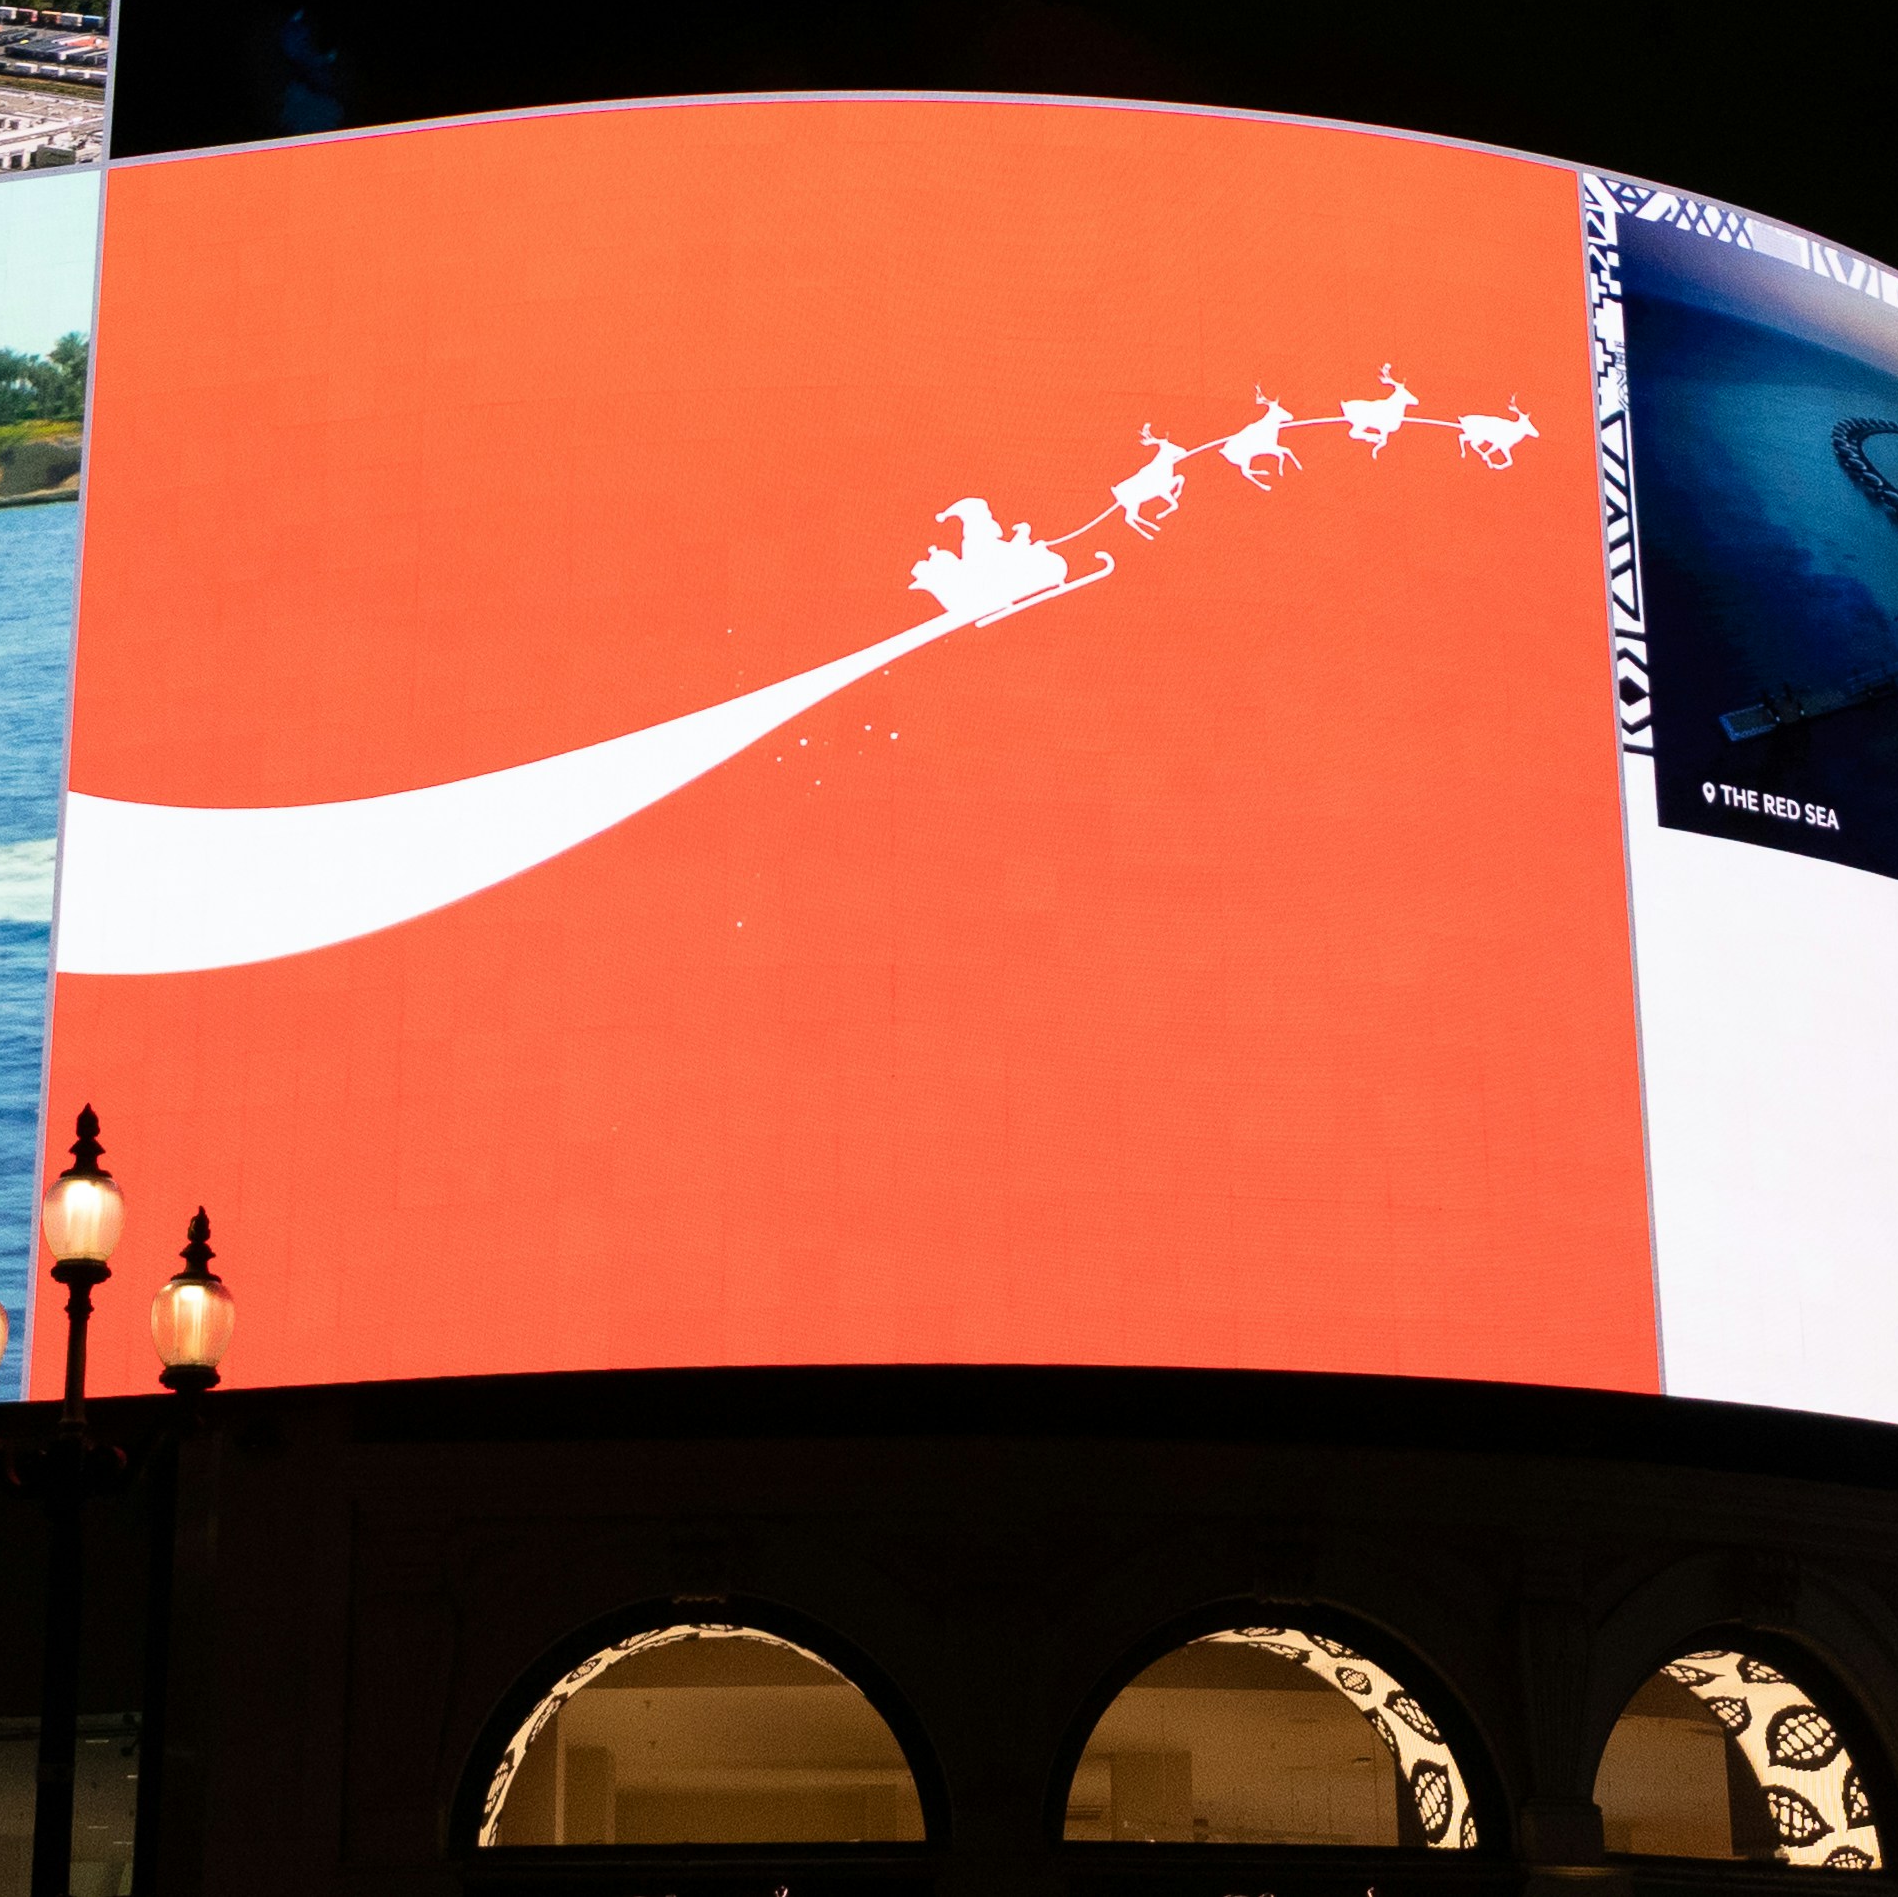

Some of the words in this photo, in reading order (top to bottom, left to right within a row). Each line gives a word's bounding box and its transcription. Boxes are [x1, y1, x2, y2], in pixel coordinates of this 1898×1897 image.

[1719, 783, 1760, 812] THE
[1762, 793, 1801, 820] RED
[1804, 802, 1840, 830] SEA
